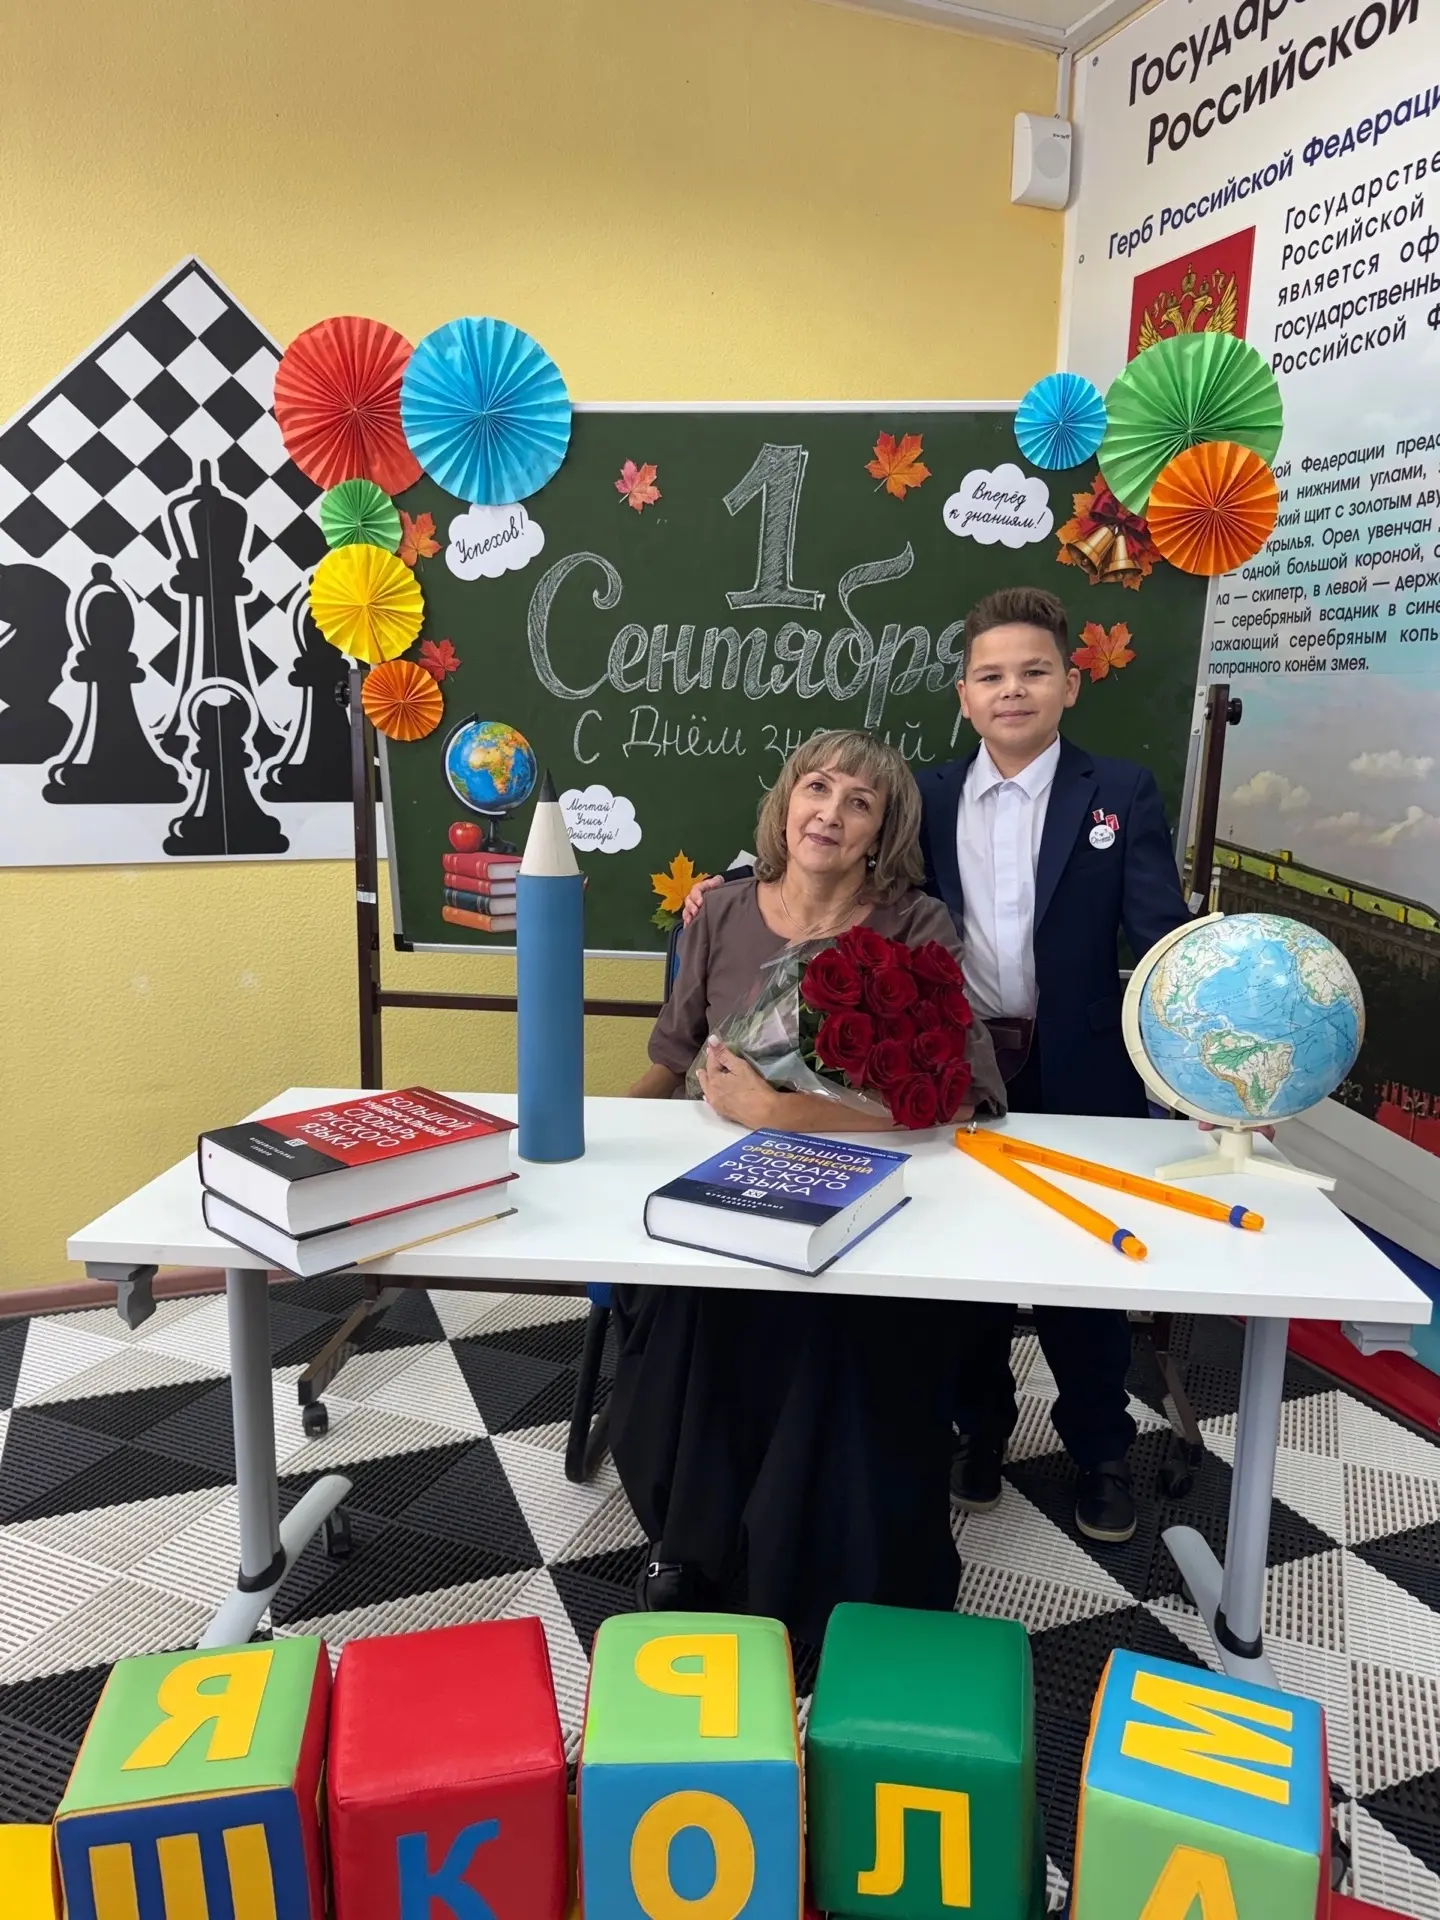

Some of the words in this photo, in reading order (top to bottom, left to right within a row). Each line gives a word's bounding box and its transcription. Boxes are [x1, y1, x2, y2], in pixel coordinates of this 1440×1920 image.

[1129, 0, 1305, 106] Государ
[1108, 215, 1153, 259] Герб
[1160, 149, 1293, 236] Российской
[1282, 192, 1424, 270] Российской
[1278, 253, 1380, 306] является
[1271, 316, 1406, 375] Российской
[1301, 444, 1385, 473] Федерации
[1296, 476, 1360, 500] нижними
[1369, 463, 1427, 491] углами,
[948, 508, 960, 519] к
[961, 510, 1046, 529] знаниям!
[1304, 507, 1331, 525] щит
[1335, 504, 1344, 518] с
[1349, 494, 1412, 517] золотым
[455, 511, 525, 564] Успехов!
[722, 443, 825, 611] 1
[1266, 536, 1315, 558] крылья.
[1322, 527, 1360, 550] Орел
[1367, 517, 1432, 545] увенчан
[1242, 561, 1280, 581] одной
[1286, 553, 1348, 577] большой
[1355, 544, 1425, 571] короной,
[1251, 585, 1307, 603] скипетр,
[1313, 583, 1321, 597] в
[1325, 576, 1368, 596] левой
[1394, 571, 1440, 592] держ
[1231, 607, 1312, 631] серебряный
[1319, 603, 1379, 622] всадник
[1388, 603, 1397, 617] в
[1289, 629, 1387, 653] серебряным
[1208, 661, 1281, 679] попранного
[1284, 657, 1327, 674] конём
[1330, 659, 1369, 672] змея.
[622, 704, 747, 758] Днём
[566, 798, 616, 812] Мечтай!
[576, 812, 609, 826] Учись!
[566, 826, 620, 845] Действуй!
[312, 1111, 400, 1148] РУССКОГО
[343, 1108, 419, 1140] СЛОВАРЬ
[358, 1100, 453, 1137] УНИВЕРСАЛЬНЫЙ
[382, 1096, 473, 1131] БОЛЬШОЙ
[296, 1122, 360, 1149] ЯЗЫКА
[740, 1154, 850, 1181] СЛОВАРЬ
[742, 1145, 874, 1174] ОРФОЭПИЧЕСКИЙ
[761, 1140, 872, 1165] БОЛЬШОЙ
[719, 1160, 847, 1190] РУССКОГО
[724, 1173, 811, 1196] ЯЗЫКА
[121, 1649, 274, 1771] Я
[857, 1782, 972, 1908] Л
